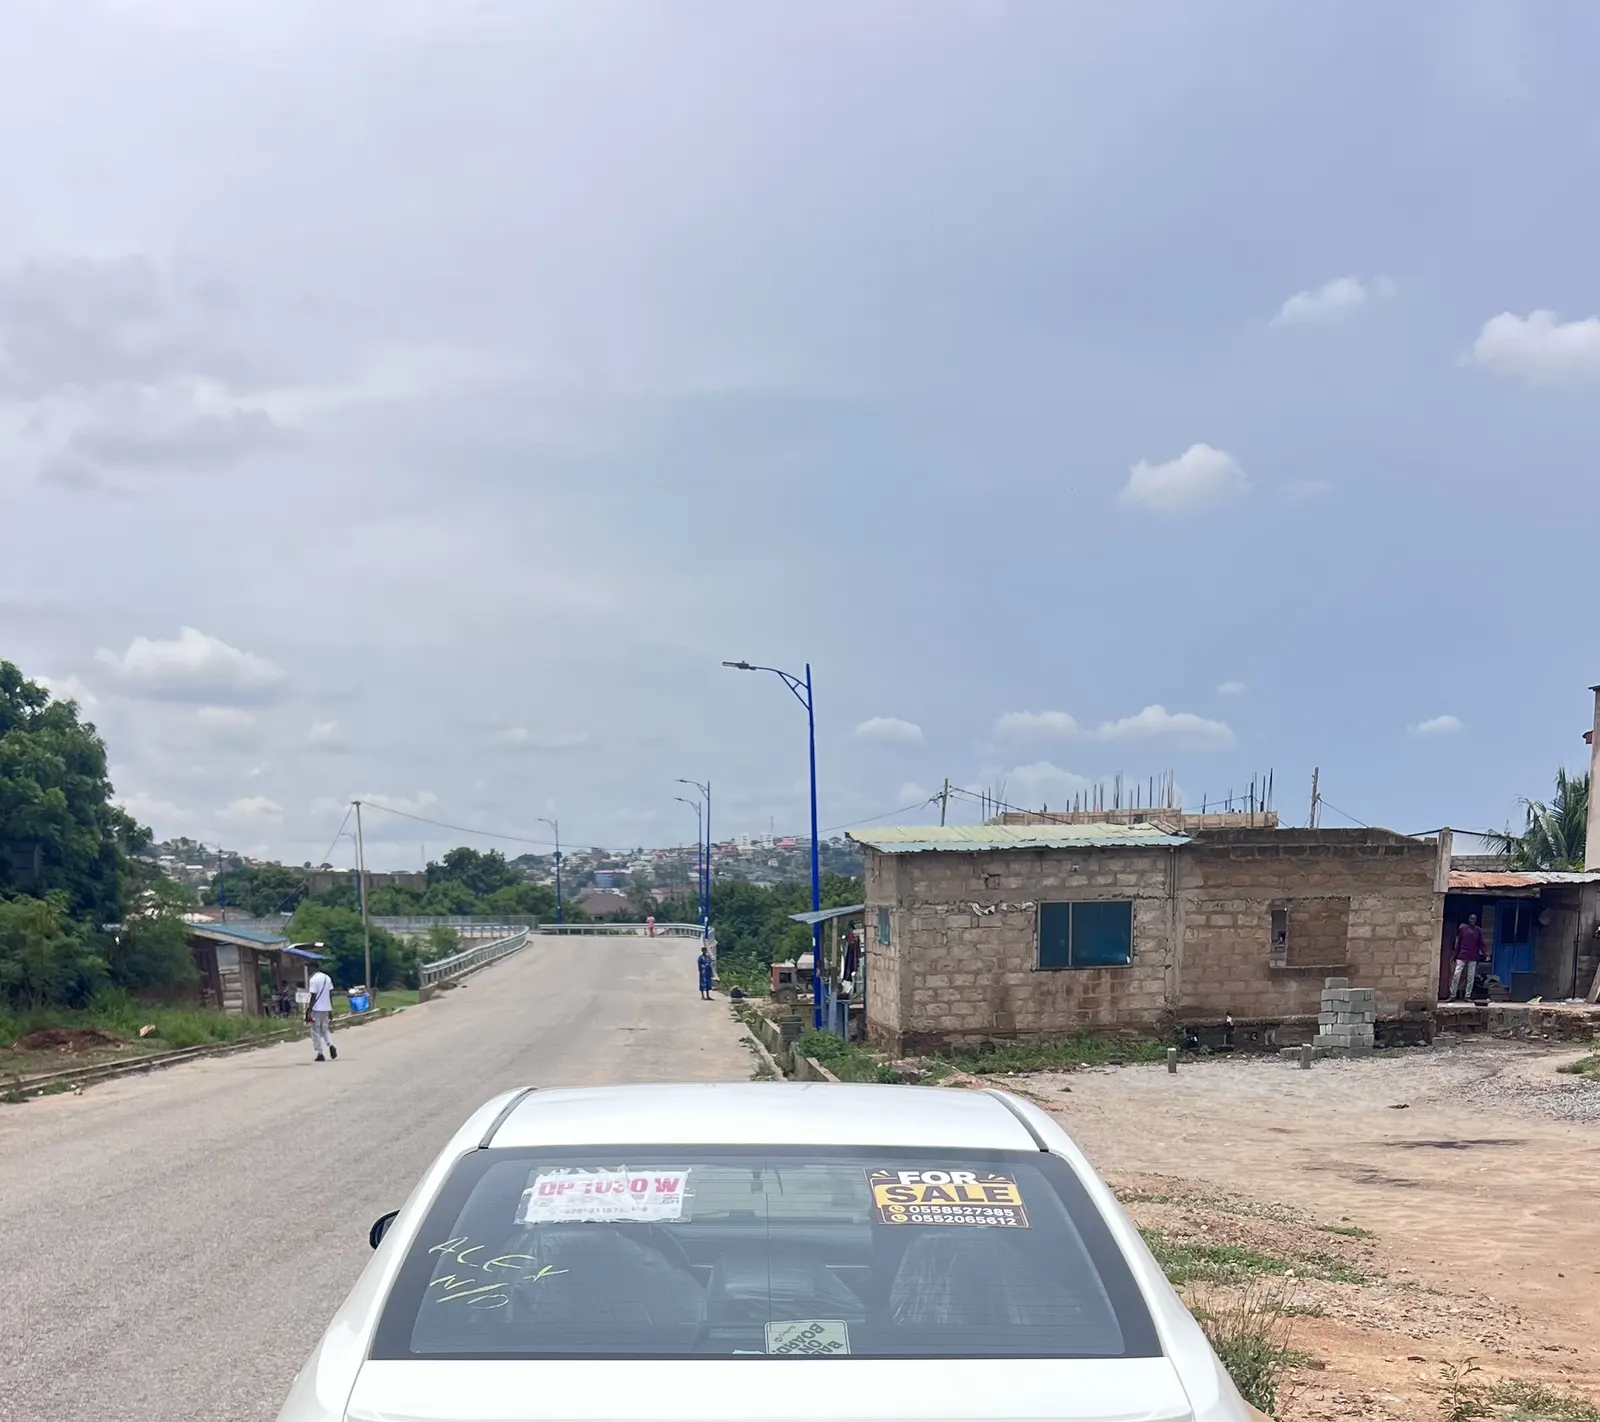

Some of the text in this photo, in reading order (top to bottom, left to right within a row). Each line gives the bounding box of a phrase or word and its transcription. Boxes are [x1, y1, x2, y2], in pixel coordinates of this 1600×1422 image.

[897, 1170, 980, 1185] FOR
[654, 1177, 680, 1193] W
[885, 1185, 1014, 1203] SALE
[909, 1205, 1015, 1217] 0558527385
[911, 1214, 1018, 1226] 0552065612
[798, 1340, 823, 1354] ON
